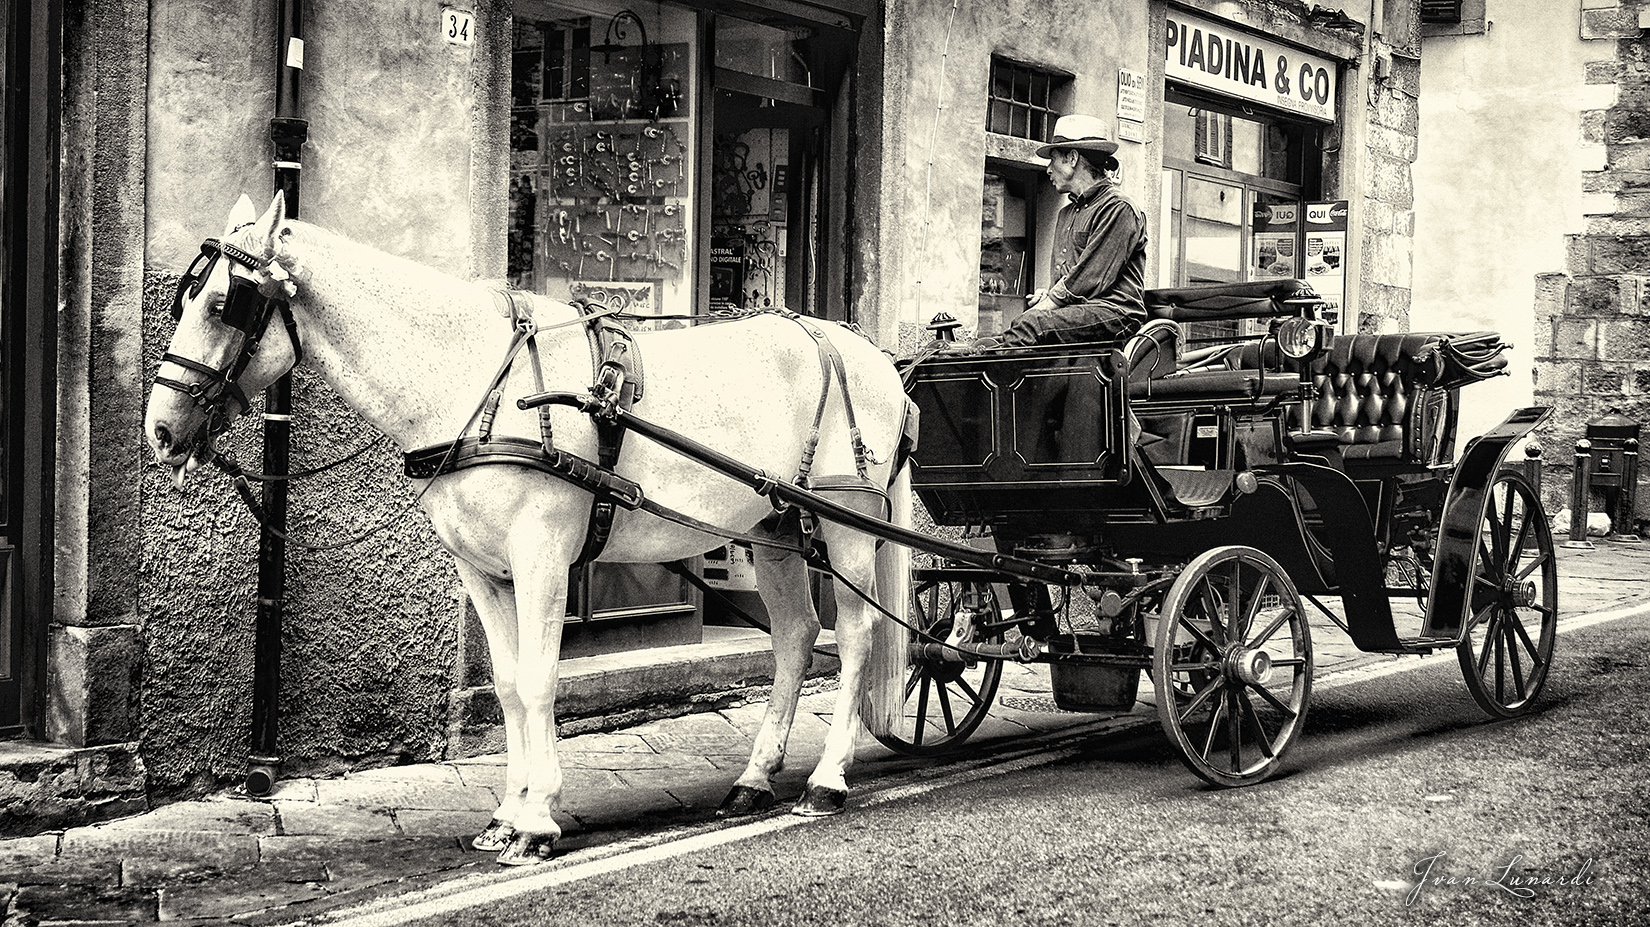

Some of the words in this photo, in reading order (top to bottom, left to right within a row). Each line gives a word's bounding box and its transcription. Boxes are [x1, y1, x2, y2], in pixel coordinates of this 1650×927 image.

[449, 14, 468, 41] 34
[1166, 19, 1267, 89] PIADINA
[1275, 55, 1291, 95] &
[1299, 62, 1329, 105] CO
[1309, 210, 1326, 219] QUI
[719, 256, 742, 264] DIGITALE
